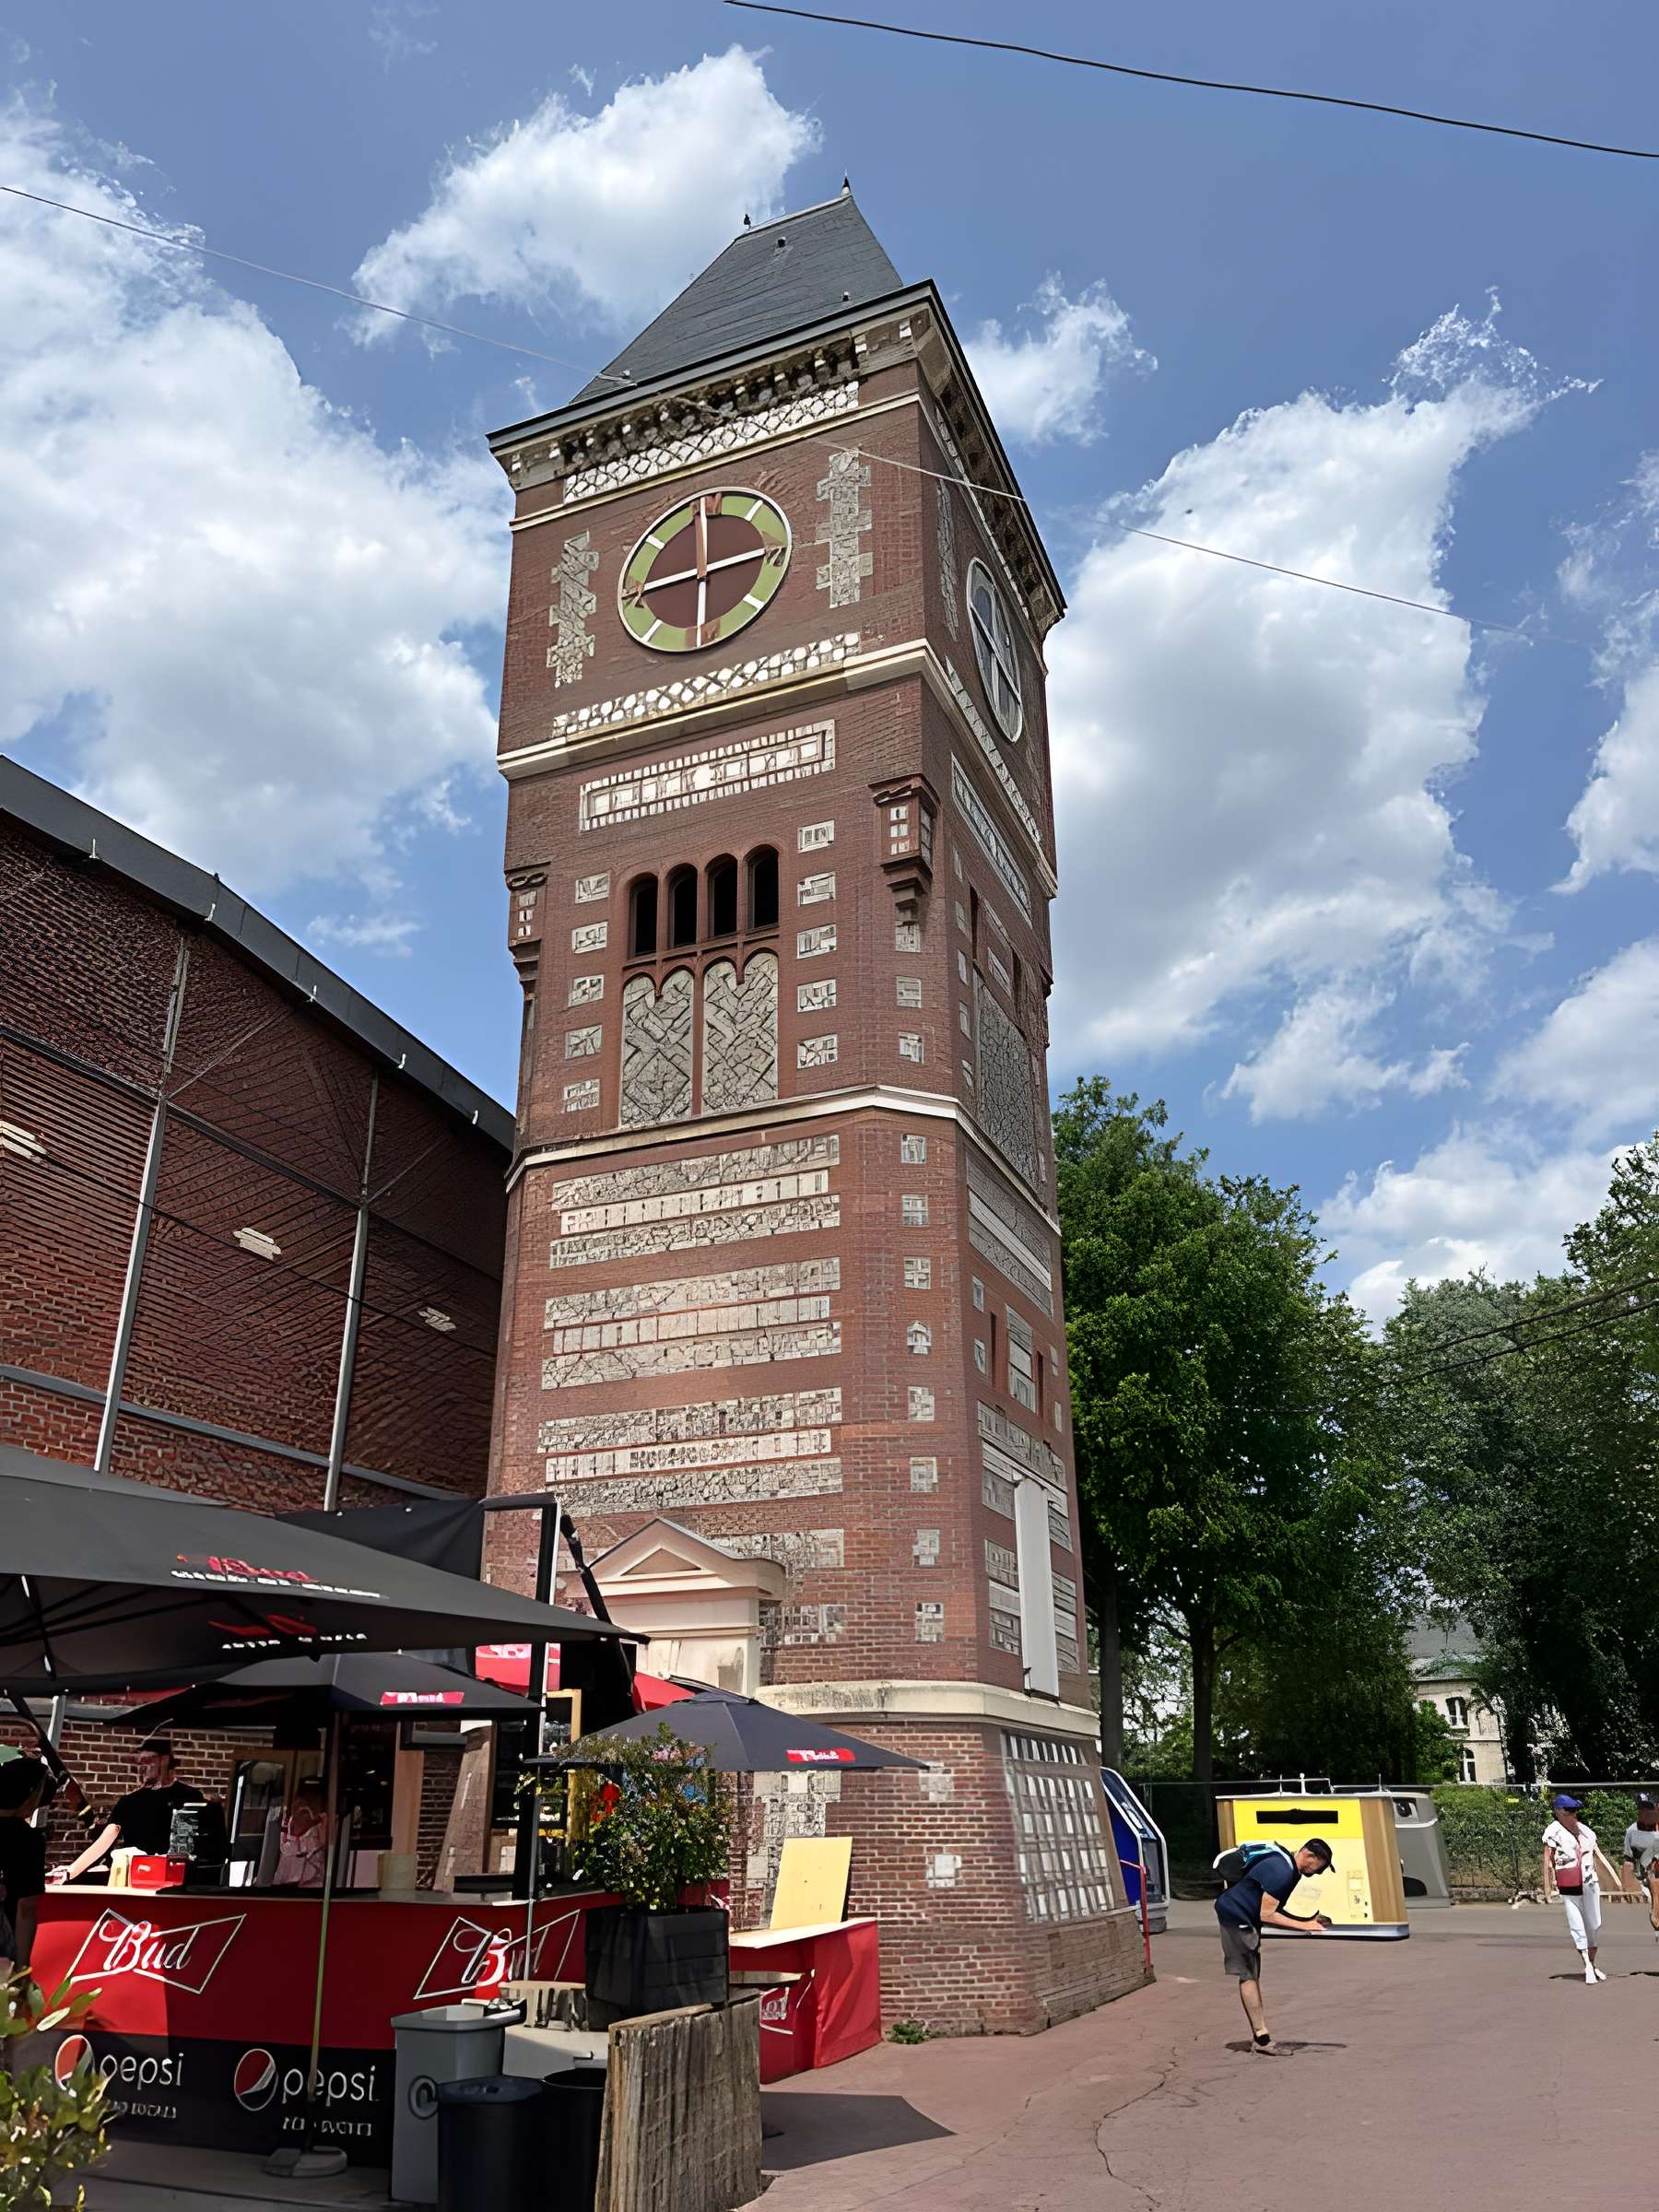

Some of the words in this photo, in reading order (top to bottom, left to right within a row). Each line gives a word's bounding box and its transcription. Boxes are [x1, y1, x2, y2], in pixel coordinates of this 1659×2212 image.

[99, 1920, 193, 1971] Bud
[100, 2053, 184, 2090] pepsi
[282, 2056, 376, 2106] pepsi
